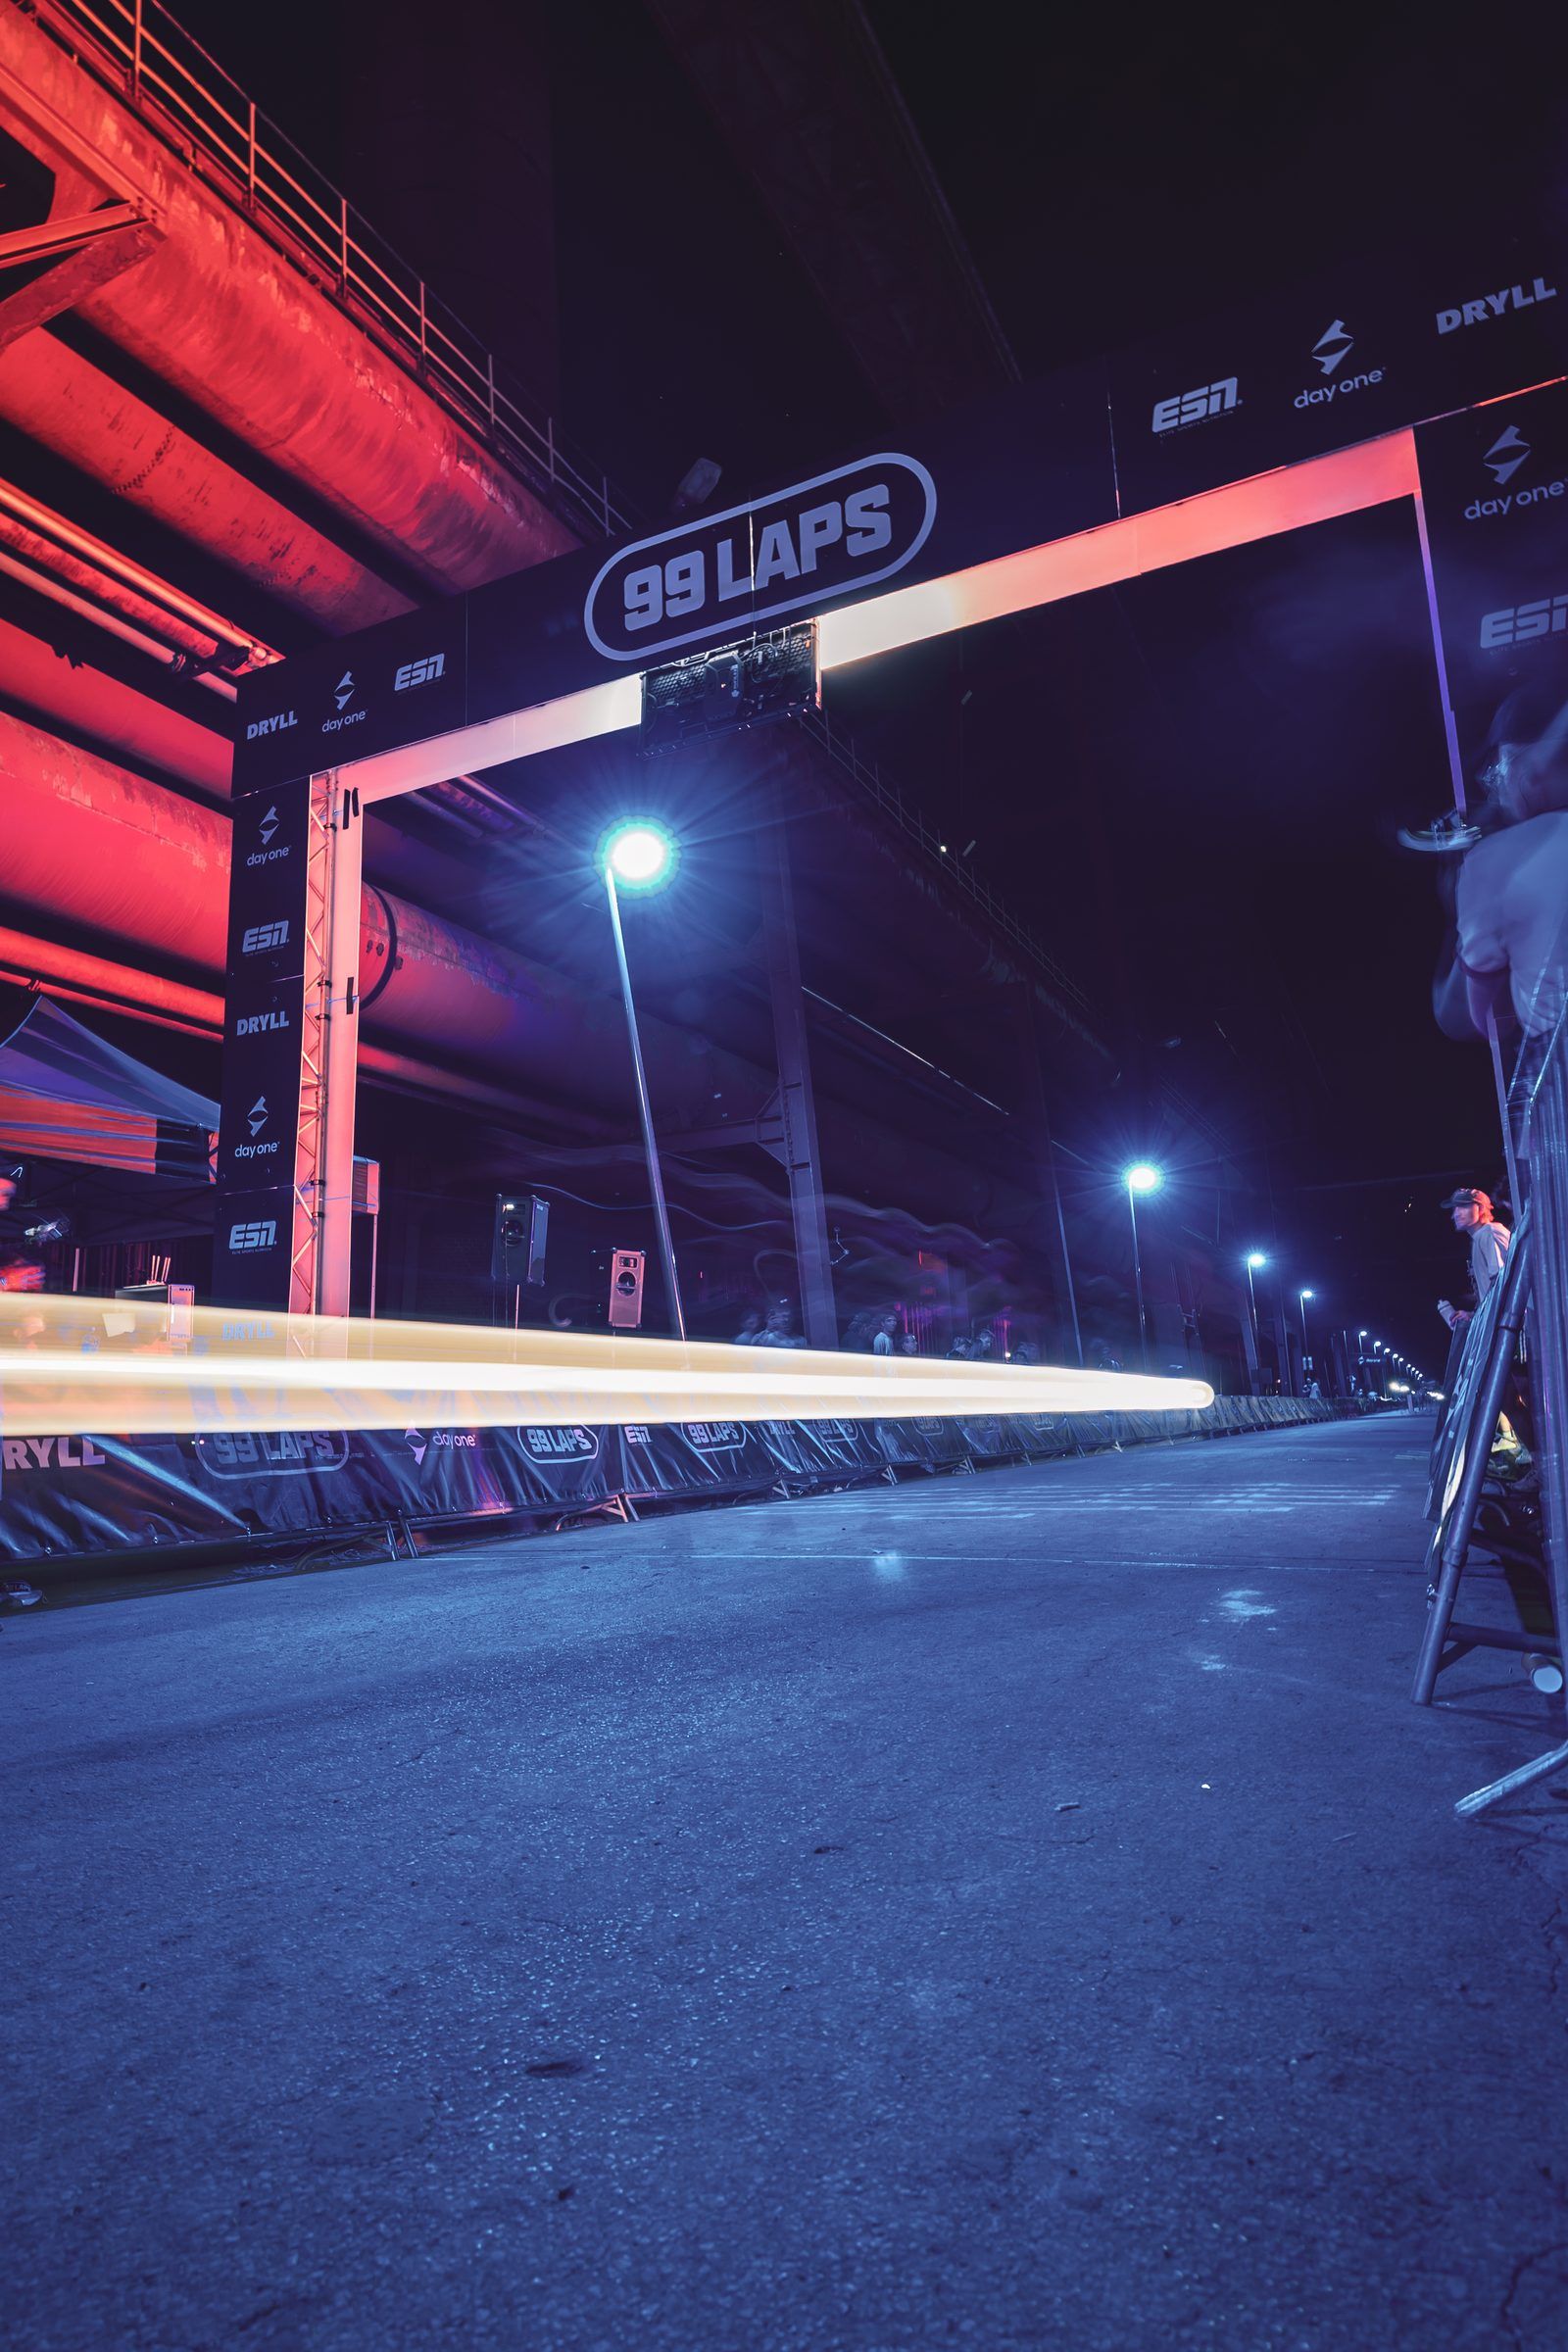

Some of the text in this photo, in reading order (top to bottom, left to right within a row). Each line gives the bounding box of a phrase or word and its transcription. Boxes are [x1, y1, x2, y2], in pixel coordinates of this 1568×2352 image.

[1436, 277, 1557, 334] DRYLL
[1294, 368, 1383, 408] day one
[1464, 481, 1565, 519] day one
[623, 484, 891, 631] 99 LAPS
[247, 710, 298, 740] DRYLL
[321, 710, 367, 733] day one
[247, 846, 290, 866] day one
[237, 1010, 290, 1036] DRYLL
[234, 1142, 278, 1158] day one
[213, 1430, 335, 1464] 99 LAPS
[454, 1435, 476, 1446] one
[527, 1429, 592, 1452] 99 LAPS
[688, 1422, 739, 1444] 99 LAPS
[3, 1437, 106, 1469] RYLL
